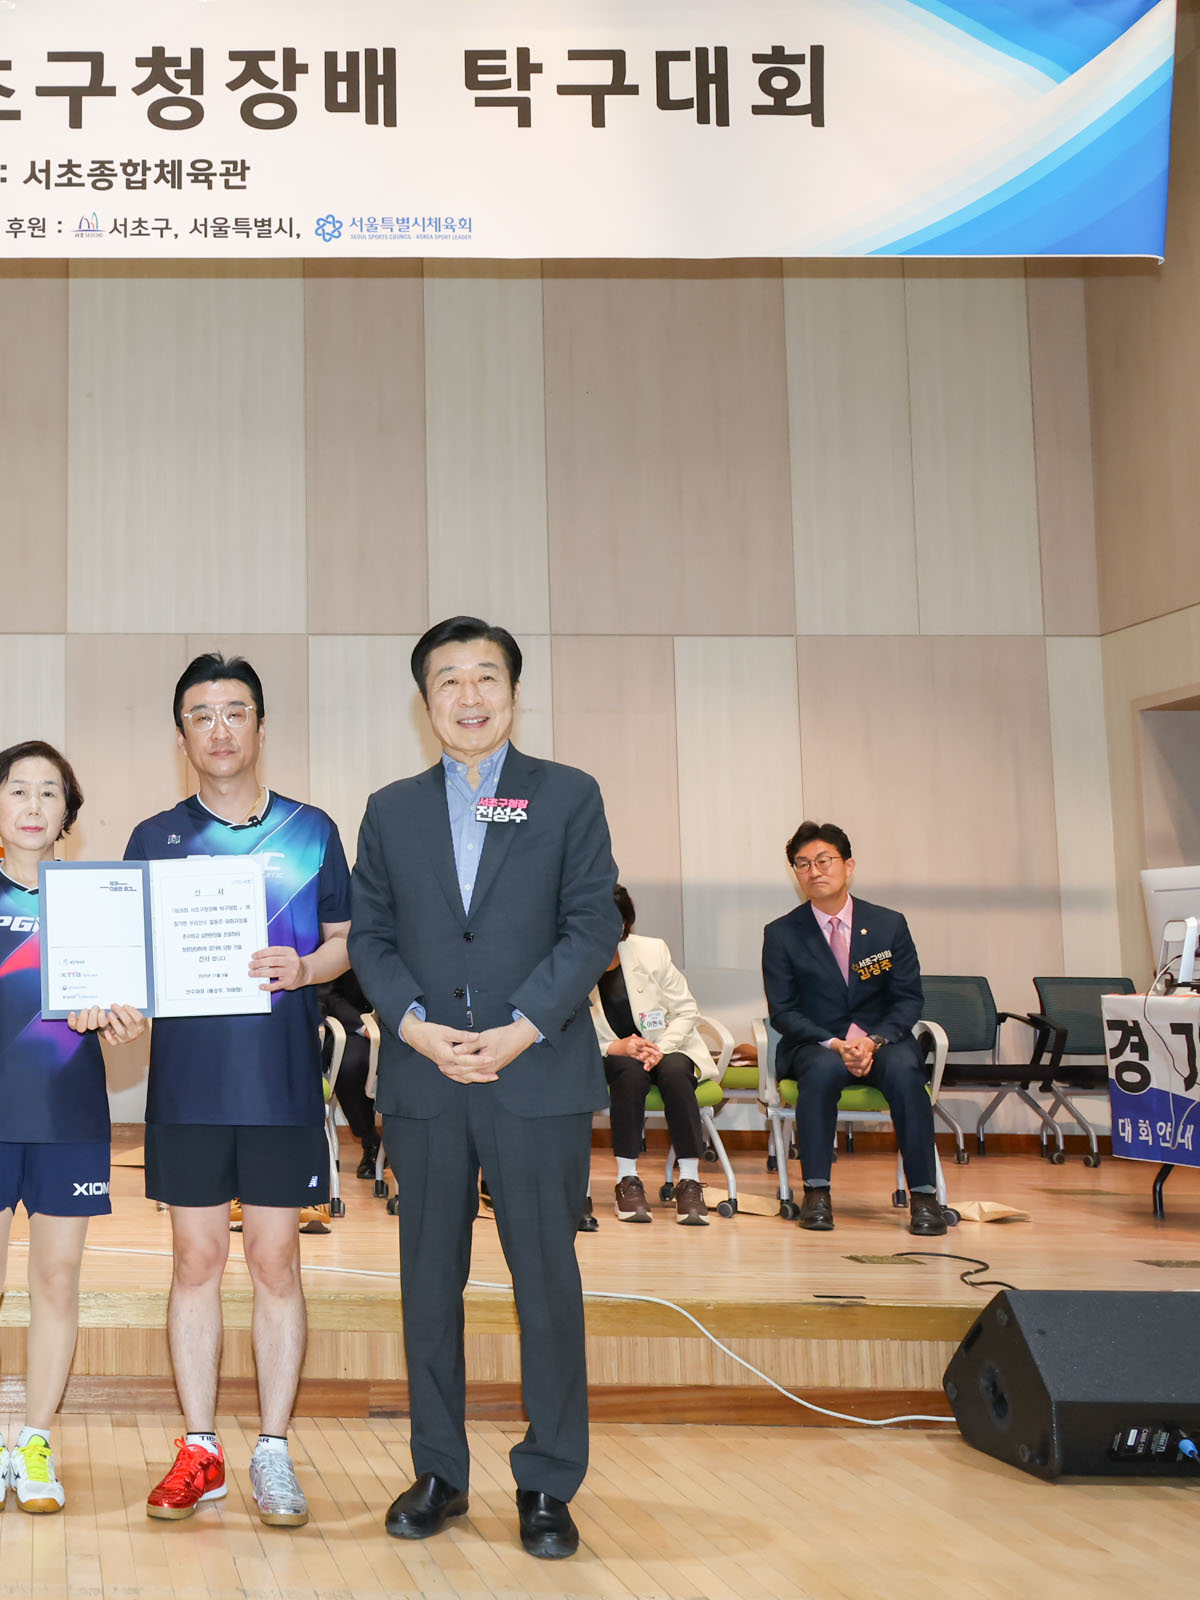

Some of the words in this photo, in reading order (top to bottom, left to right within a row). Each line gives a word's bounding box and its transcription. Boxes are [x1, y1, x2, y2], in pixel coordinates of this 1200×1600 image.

[464, 45, 824, 128] 탁구대회
[23, 159, 250, 191] 서초종합체육관
[6, 217, 47, 238] 후원
[109, 217, 179, 239] 서초구,
[189, 217, 301, 239] 서울특별시,
[349, 216, 472, 233] 서울특별시체육회
[476, 805, 528, 823] 전성수
[857, 959, 893, 981] 김성주
[858, 950, 893, 968] 서초구의원
